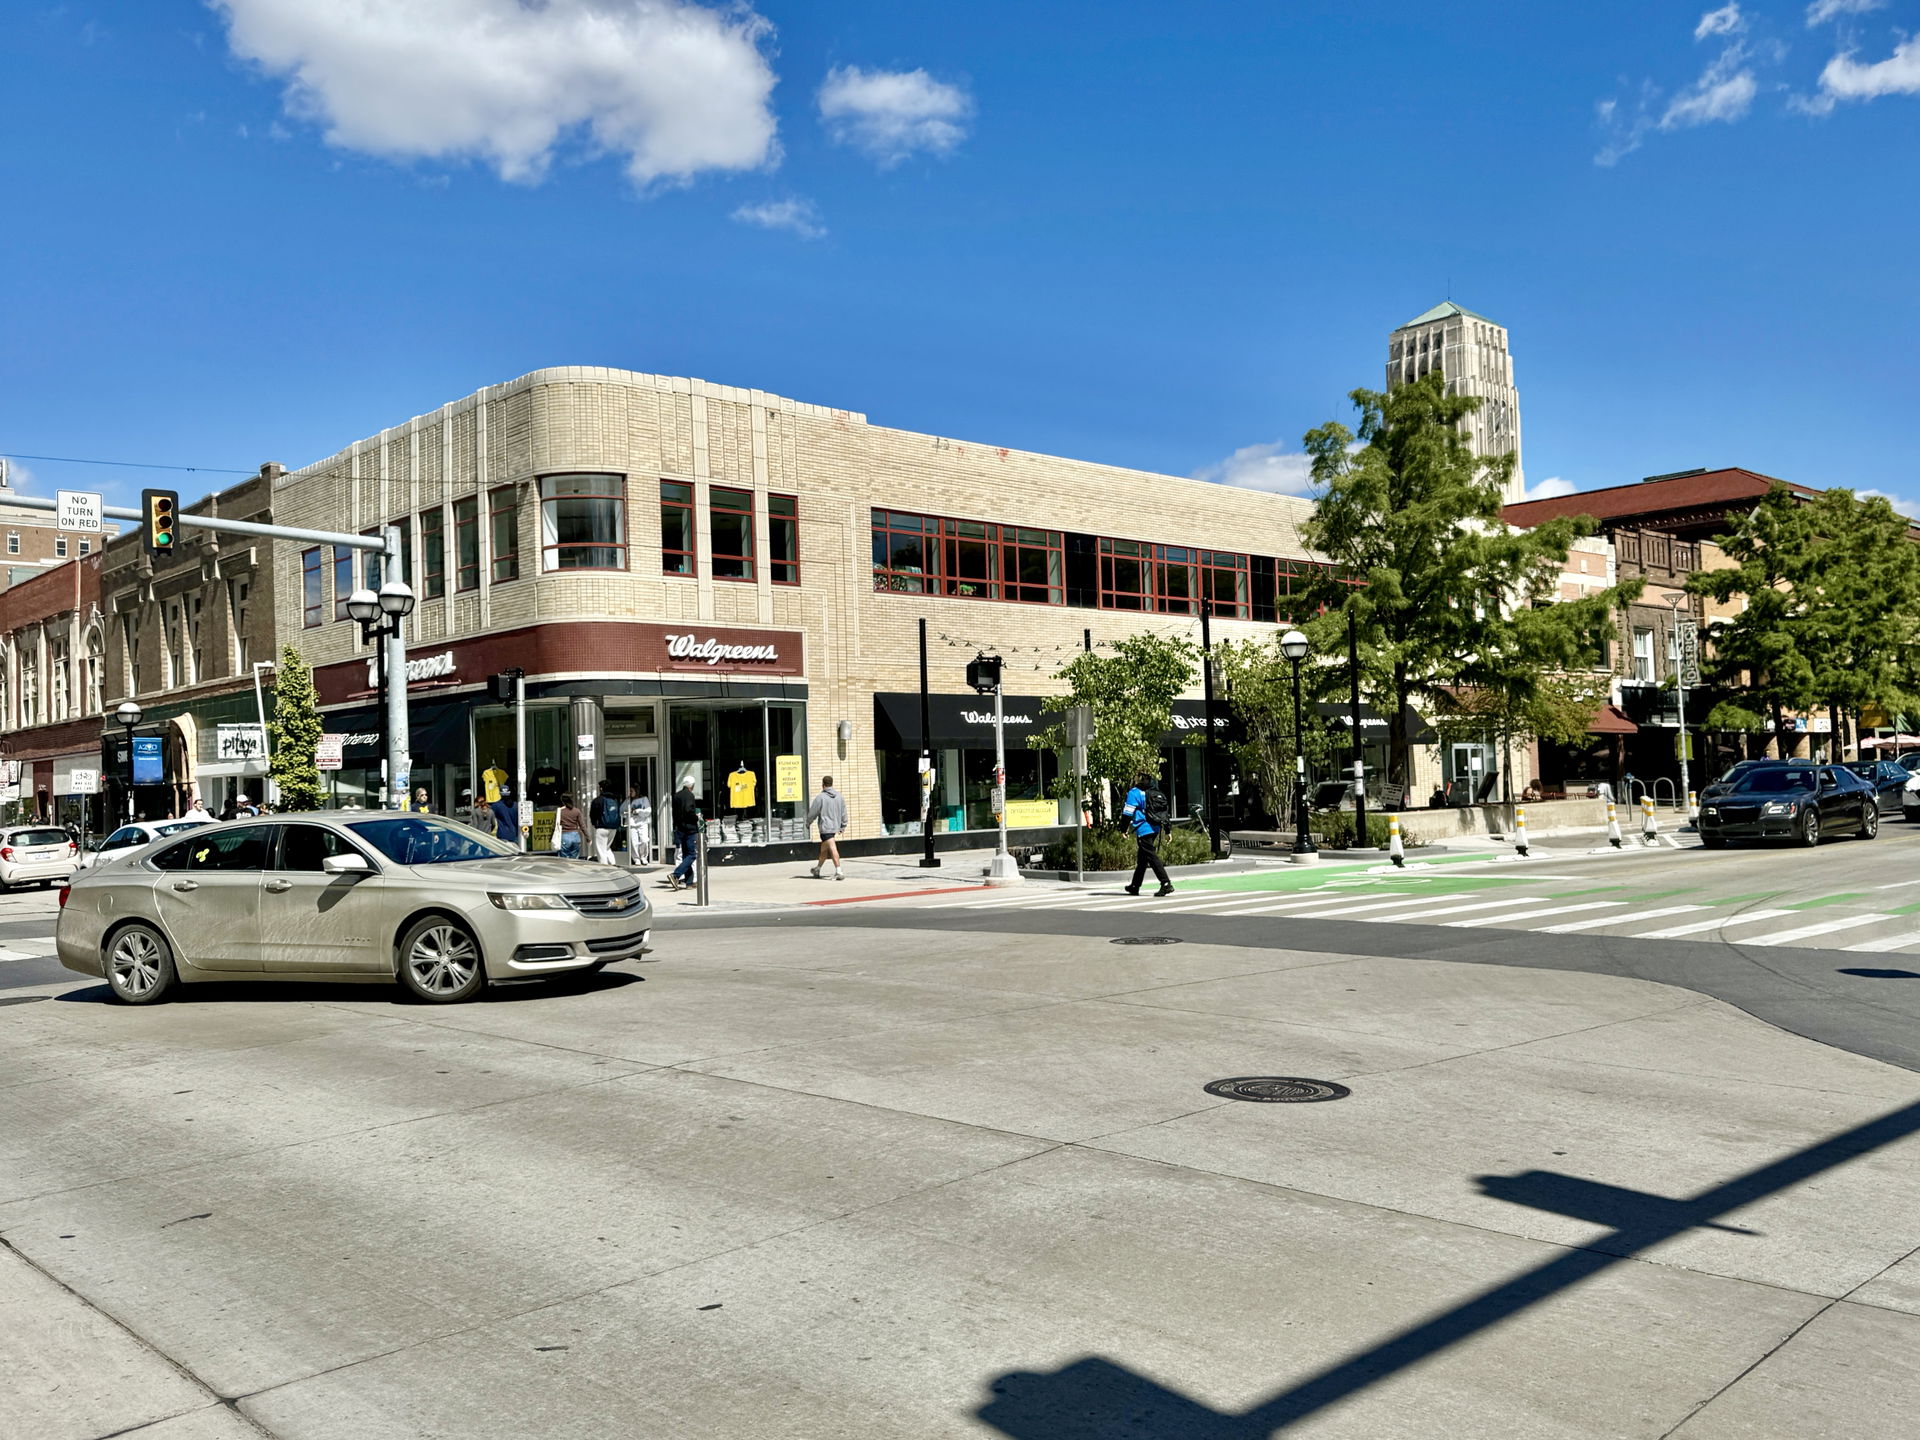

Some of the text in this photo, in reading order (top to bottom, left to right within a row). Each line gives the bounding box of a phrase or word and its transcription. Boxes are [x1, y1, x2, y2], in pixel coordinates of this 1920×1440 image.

[72, 496, 87, 504] NO
[67, 507, 93, 516] TURN
[61, 518, 98, 528] ON RED
[665, 634, 778, 665] Walgreens
[960, 710, 1033, 728] Walgeens
